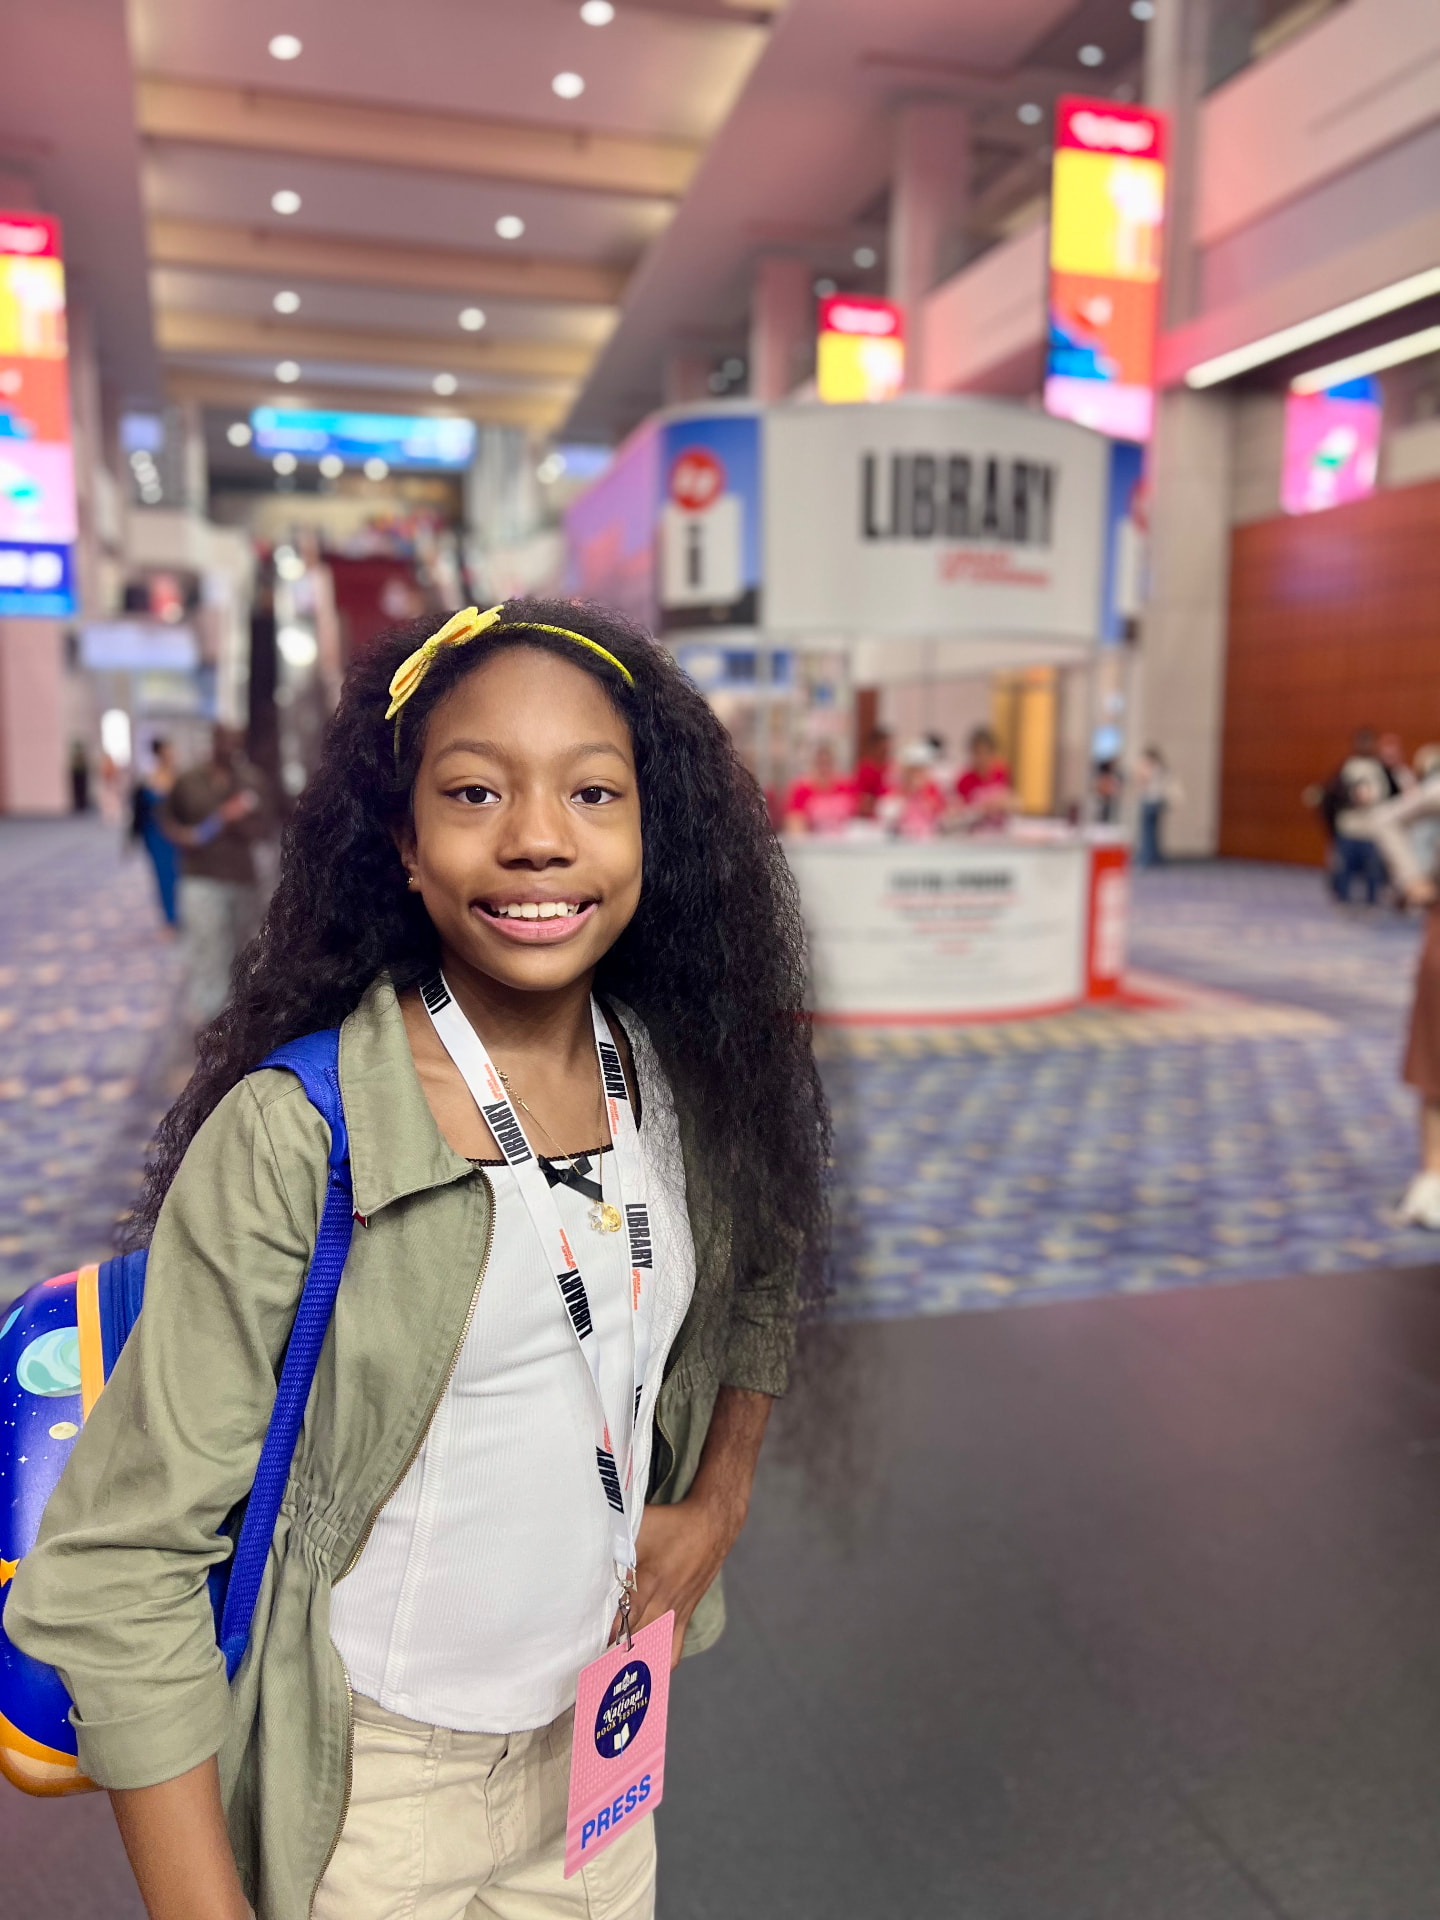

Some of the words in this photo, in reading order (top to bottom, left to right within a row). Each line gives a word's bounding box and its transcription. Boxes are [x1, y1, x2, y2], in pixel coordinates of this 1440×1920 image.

[862, 451, 1057, 547] LIBRARY
[599, 1041, 627, 1100] LIBRARY
[483, 1100, 532, 1165] LIBRARY
[625, 1203, 652, 1268] LIBRARY
[557, 1269, 593, 1340] LIBRARY
[596, 1446, 624, 1514] LIBRARY
[597, 1720, 616, 1739] BOOK
[619, 1697, 648, 1723] FESTIVAL
[603, 1684, 644, 1723] National
[581, 1774, 651, 1849] PRESS
